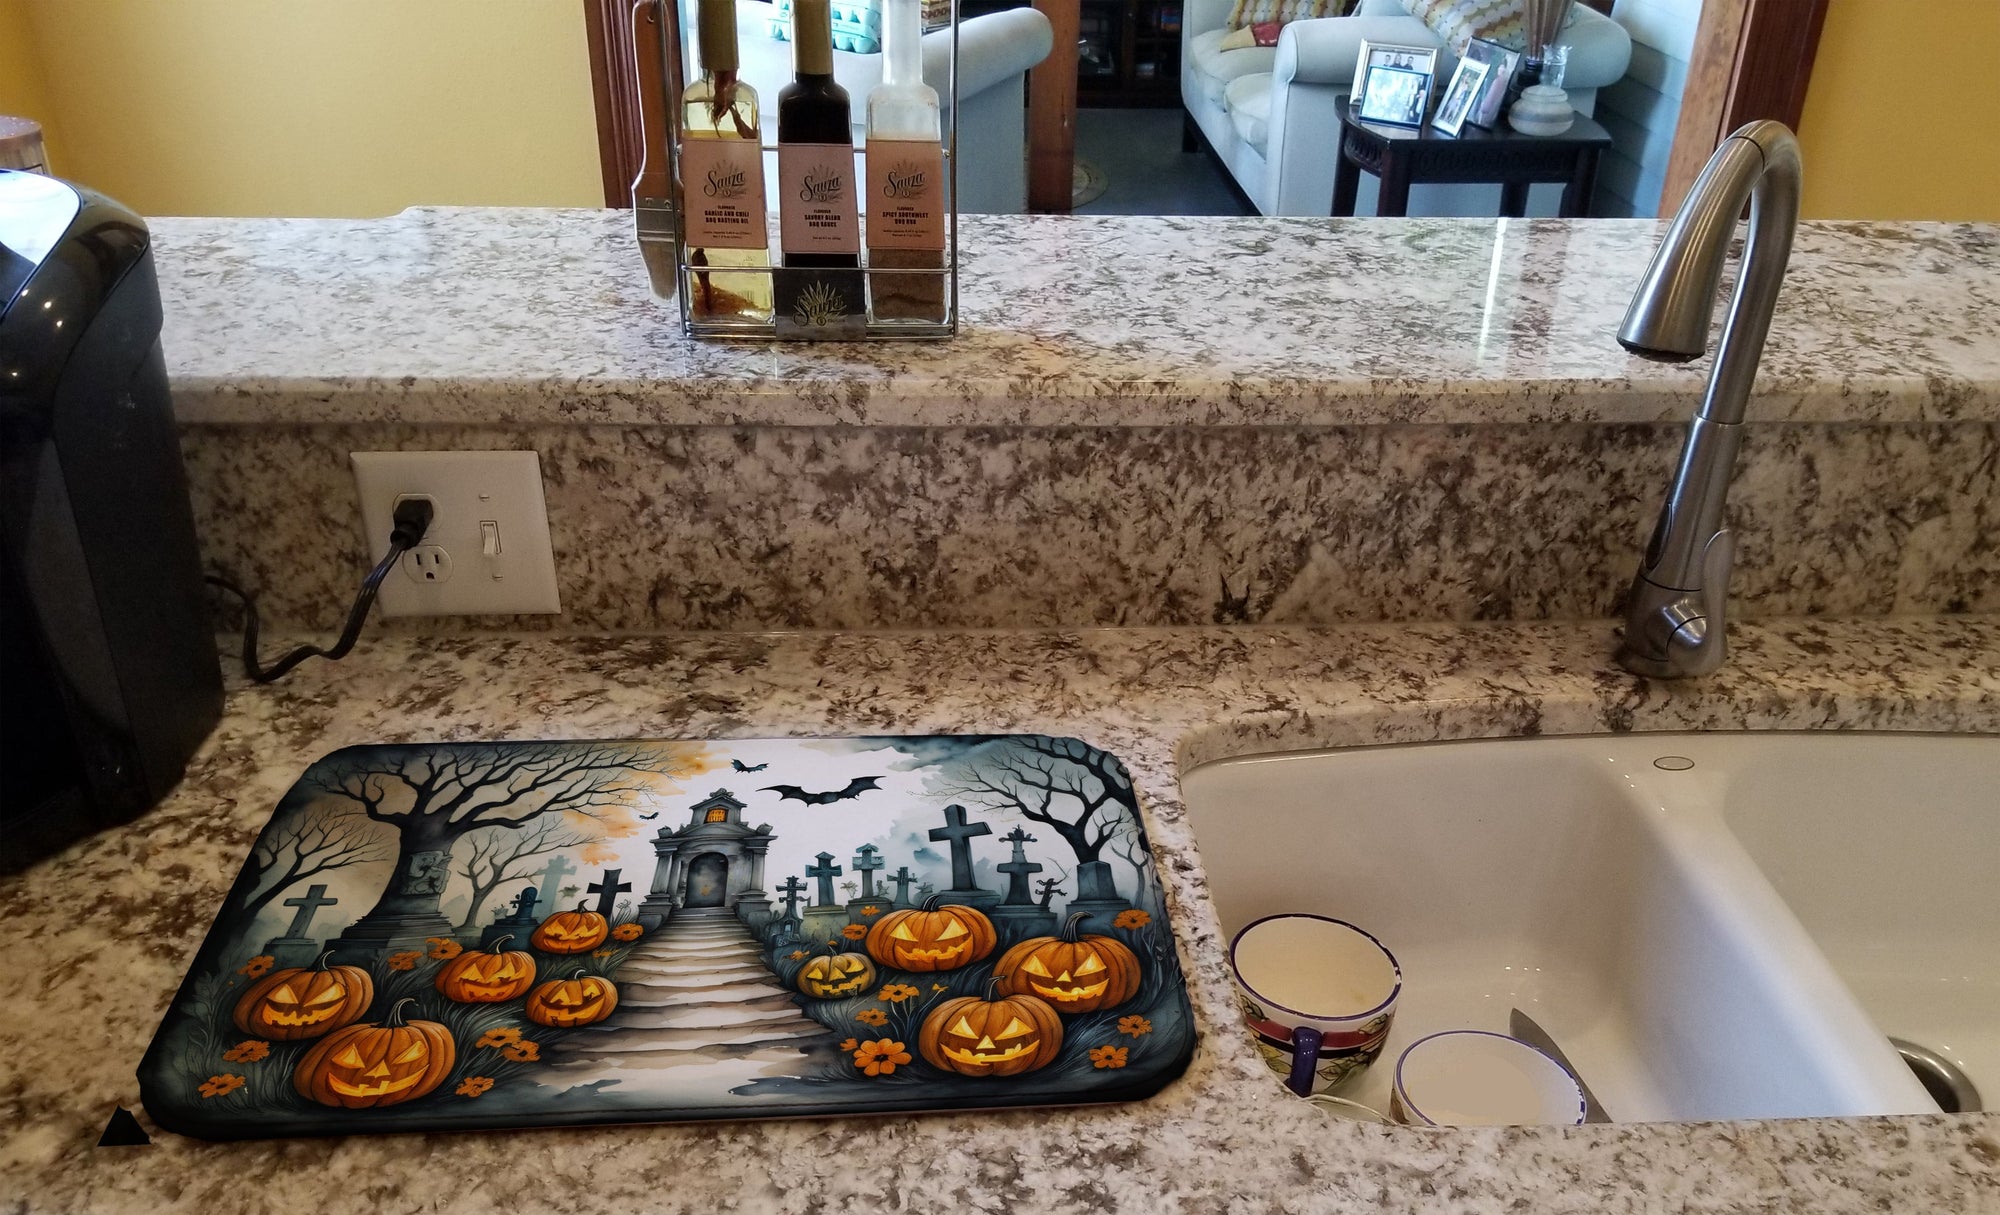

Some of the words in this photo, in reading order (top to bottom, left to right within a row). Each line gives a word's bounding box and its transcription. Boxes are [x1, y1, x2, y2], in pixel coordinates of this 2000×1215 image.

[704, 170, 745, 197] Sauza
[800, 175, 841, 202] Sauza
[884, 172, 924, 198] Sauza
